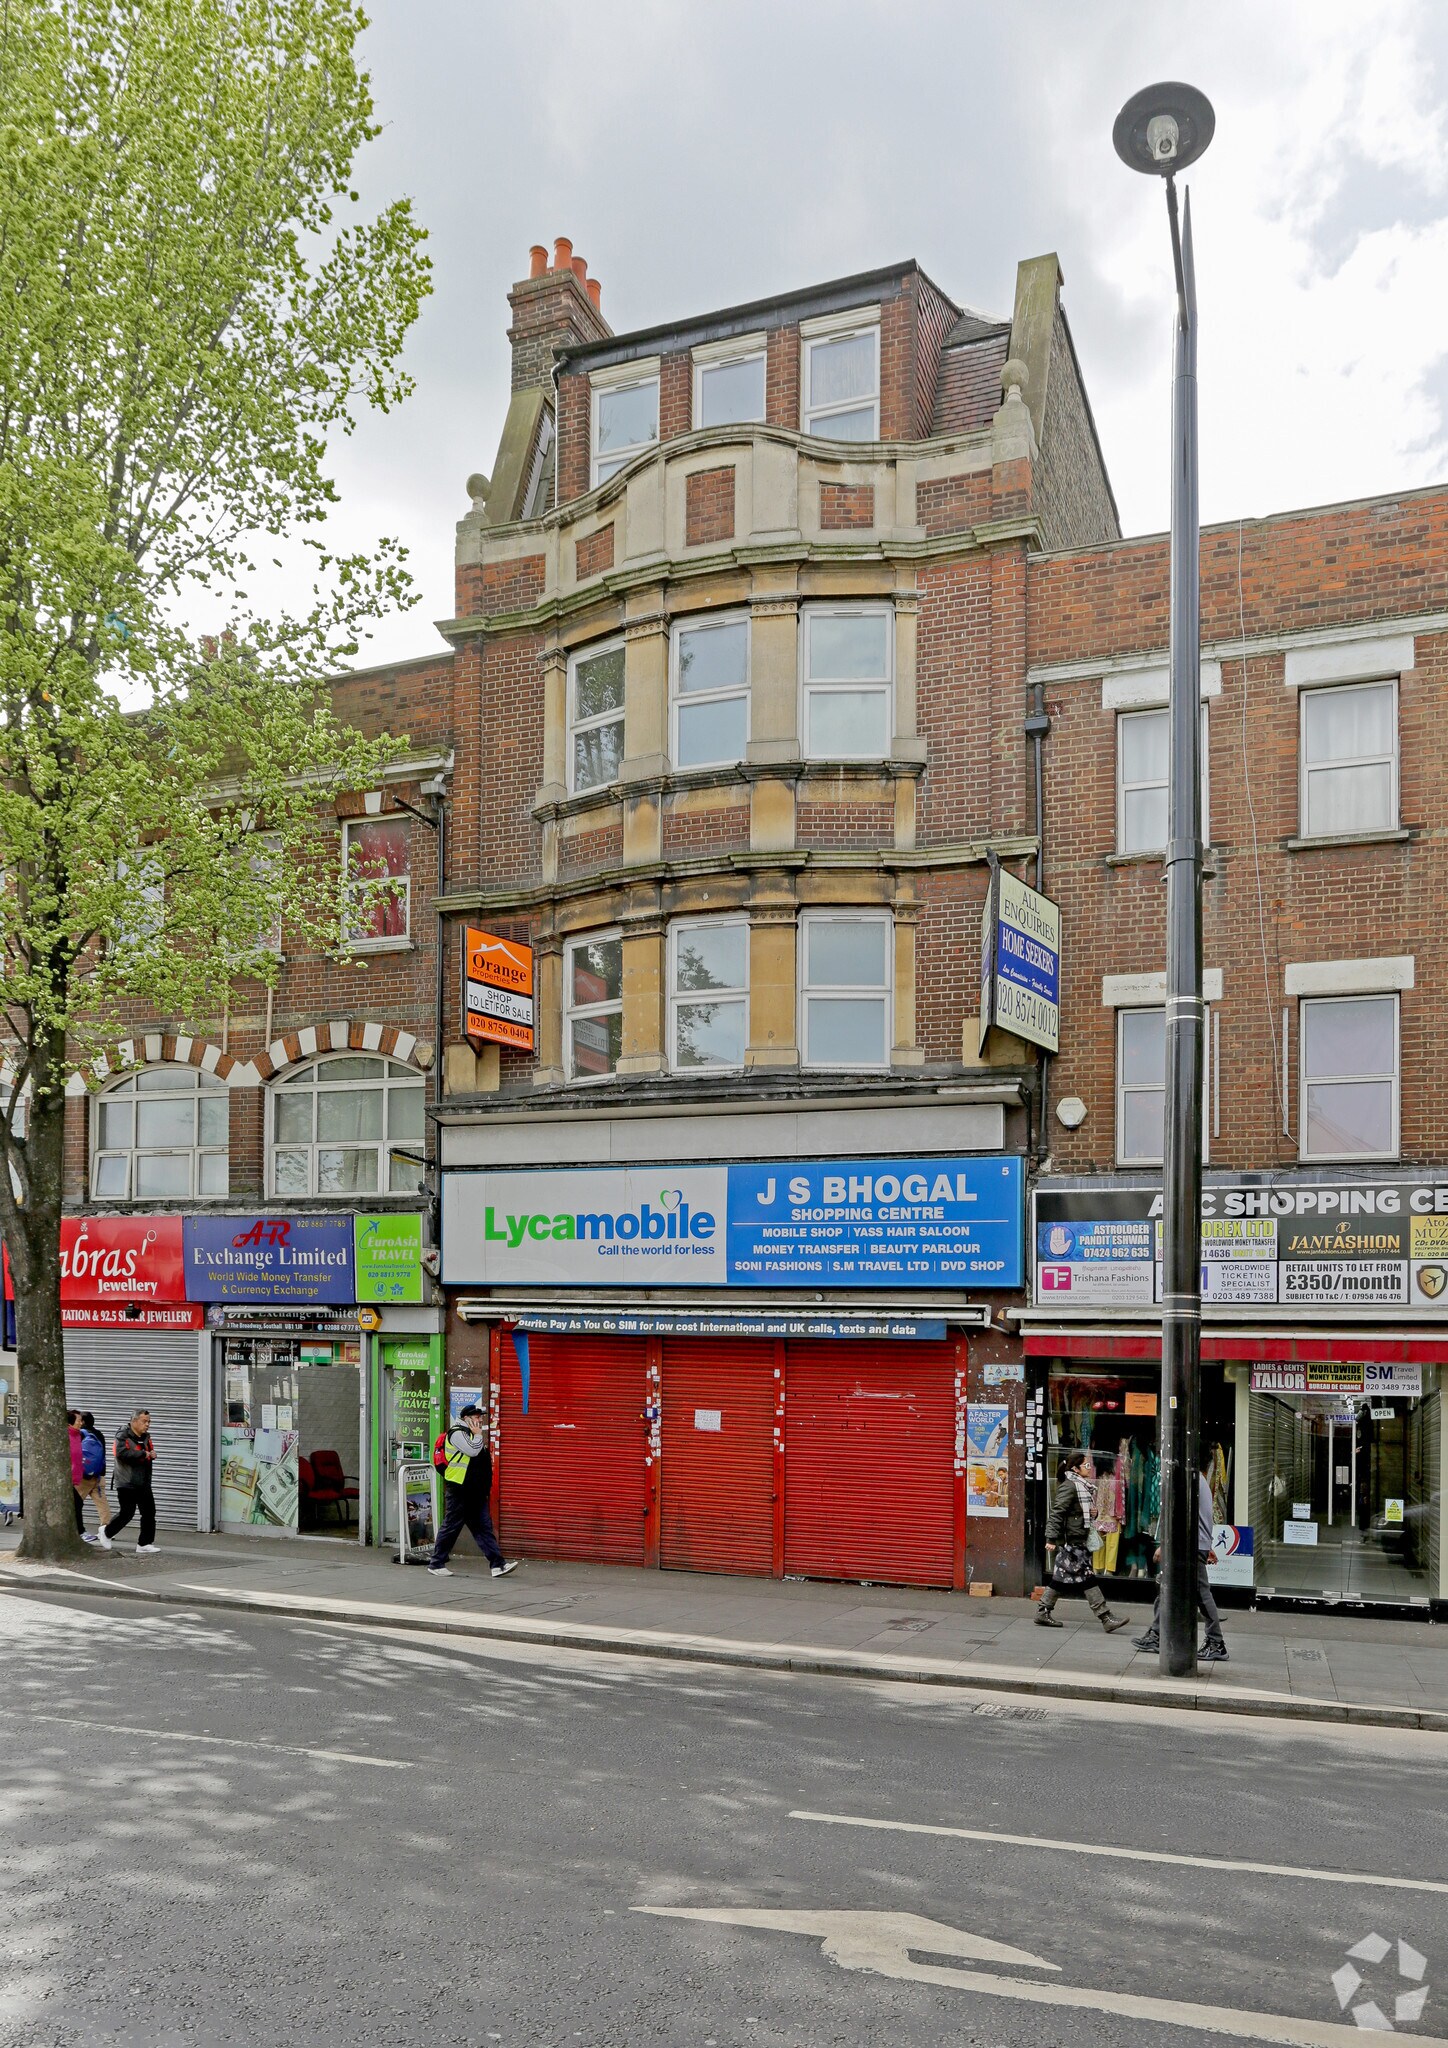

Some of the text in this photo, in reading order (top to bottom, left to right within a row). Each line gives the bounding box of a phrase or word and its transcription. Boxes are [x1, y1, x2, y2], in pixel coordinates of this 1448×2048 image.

[1022, 890, 1040, 914] ALL
[1004, 898, 1055, 943] ENQUIRIES
[1002, 926, 1054, 976] HOME SEEKERS
[473, 954, 527, 984] Orange
[473, 966, 510, 984] Properties
[488, 990, 512, 1003] SHOP
[469, 994, 530, 1021] TO LET/FOR SALE
[997, 981, 1012, 1016] 020
[1016, 990, 1036, 1026] 8574
[1038, 1002, 1056, 1037] 0012
[471, 1016, 529, 1040] 020 8756 0404
[1002, 1167, 1009, 1175] 5
[757, 1173, 977, 1205] J S BHOGAL
[1224, 1189, 1400, 1216] SHOPPING
[791, 1206, 944, 1221] SHOPPING CENTRE
[484, 1203, 716, 1248] Lycamobile
[762, 1226, 970, 1238] MOBILE SHOP YASS HAIR SALOON
[1094, 1225, 1149, 1234] ASTROLOGER
[1246, 1220, 1274, 1238] LTD
[368, 1235, 418, 1247] EuroAsia
[1080, 1235, 1149, 1245] PANDIT ESHWAR
[1288, 1235, 1400, 1250] JANFASHION
[372, 1250, 414, 1260] TRAVEL
[598, 1244, 714, 1255] Call the world for less
[753, 1244, 981, 1255] MONEY TRANSFER BEAUTY PARLOUR
[1084, 1248, 1149, 1257] 07424 962 635
[194, 1247, 347, 1269] Exchange Limited
[735, 1261, 1004, 1271] SONI FASHIONS S.M TRAVEL LTD DVD SHOP
[1286, 1263, 1401, 1272] RETAIL UNITS TO LET FROM
[208, 1272, 331, 1284] World Wide Money Transfer
[1286, 1274, 1401, 1290] £350/month
[98, 1278, 158, 1295] Jewellery
[230, 1285, 319, 1296] Currency Exchange
[101, 1311, 116, 1321] 92.5
[147, 1311, 192, 1324] JEWELLERY
[550, 1319, 916, 1335] Pay As You Go SIM for low cost International and UK calls, texts and data
[225, 1353, 298, 1362] India Sri Lanka
[1309, 1364, 1361, 1374] WORLDWIDE
[1366, 1366, 1392, 1380] SM
[1253, 1373, 1305, 1389] TAILOR
